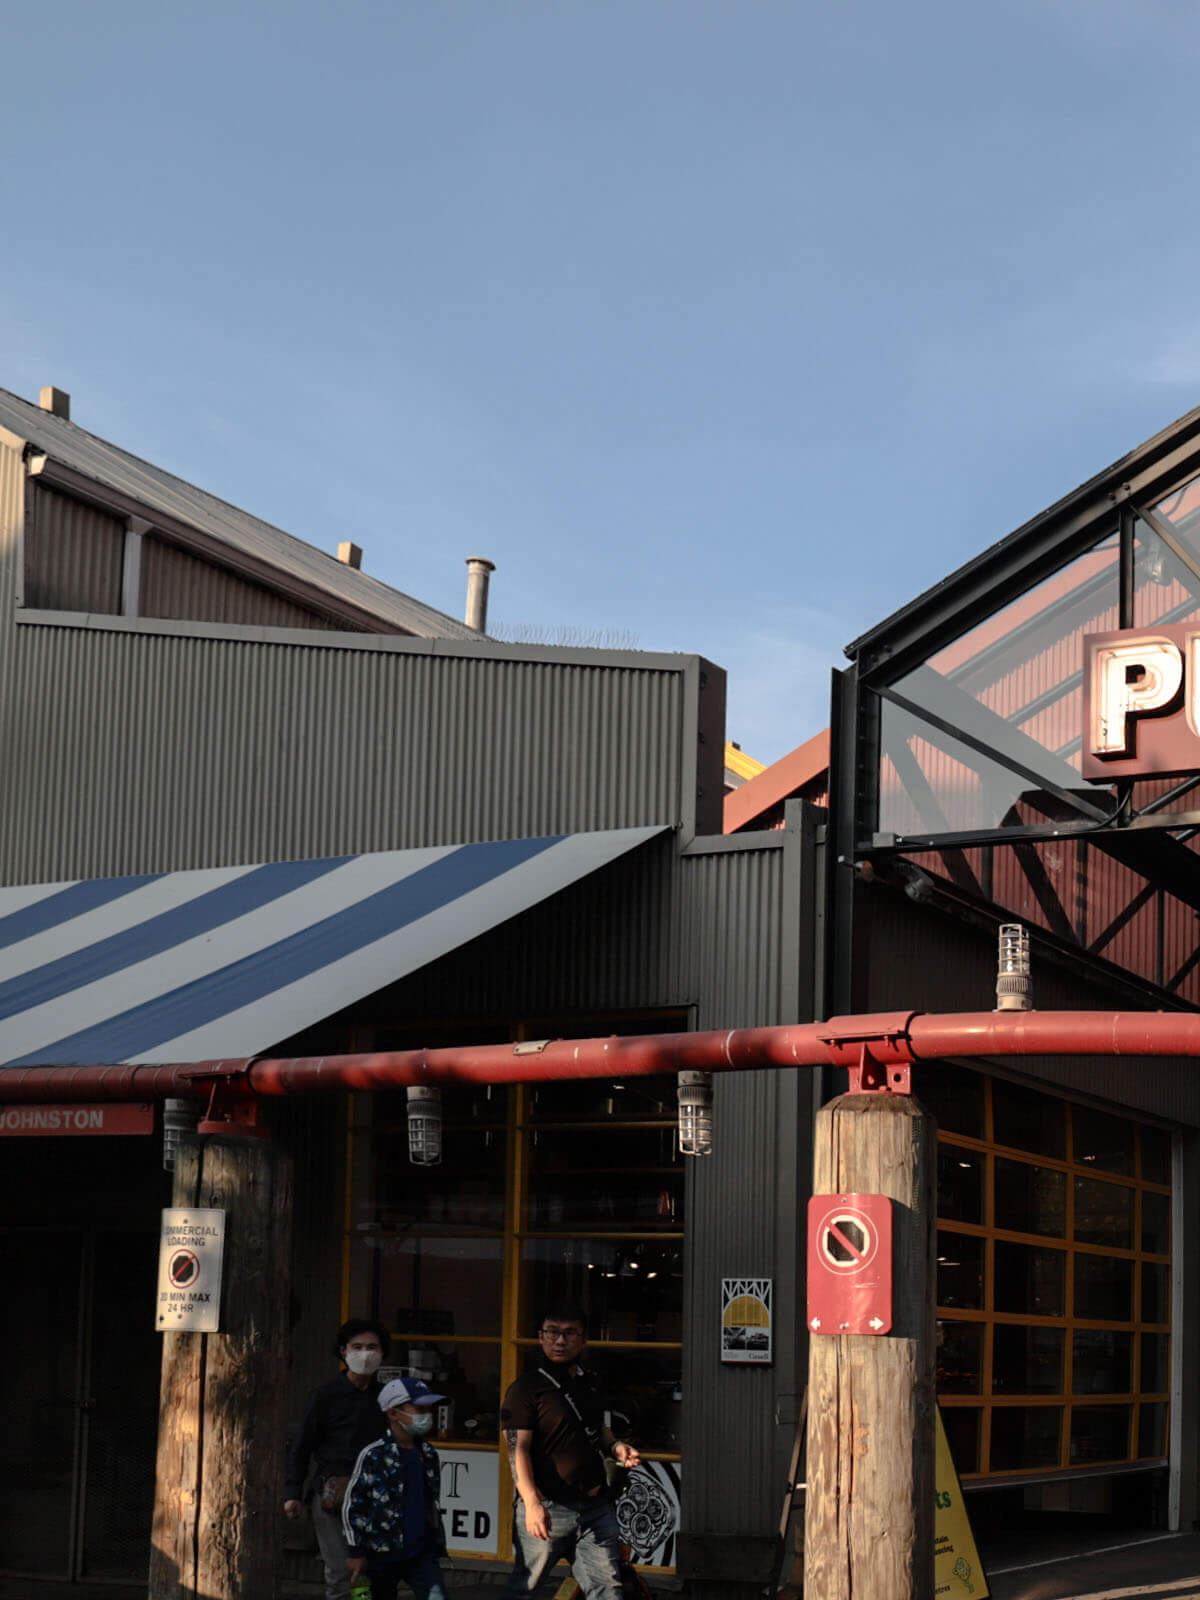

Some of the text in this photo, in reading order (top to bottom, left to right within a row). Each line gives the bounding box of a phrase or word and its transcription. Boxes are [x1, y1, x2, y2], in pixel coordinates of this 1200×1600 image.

[0, 1109, 104, 1129] JOHNSTON
[162, 1226, 218, 1237] OMMERCIAL
[167, 1236, 206, 1247] LOADING
[169, 1292, 186, 1302] MIN
[188, 1292, 211, 1303] MAX
[167, 1303, 194, 1313] 24 HR
